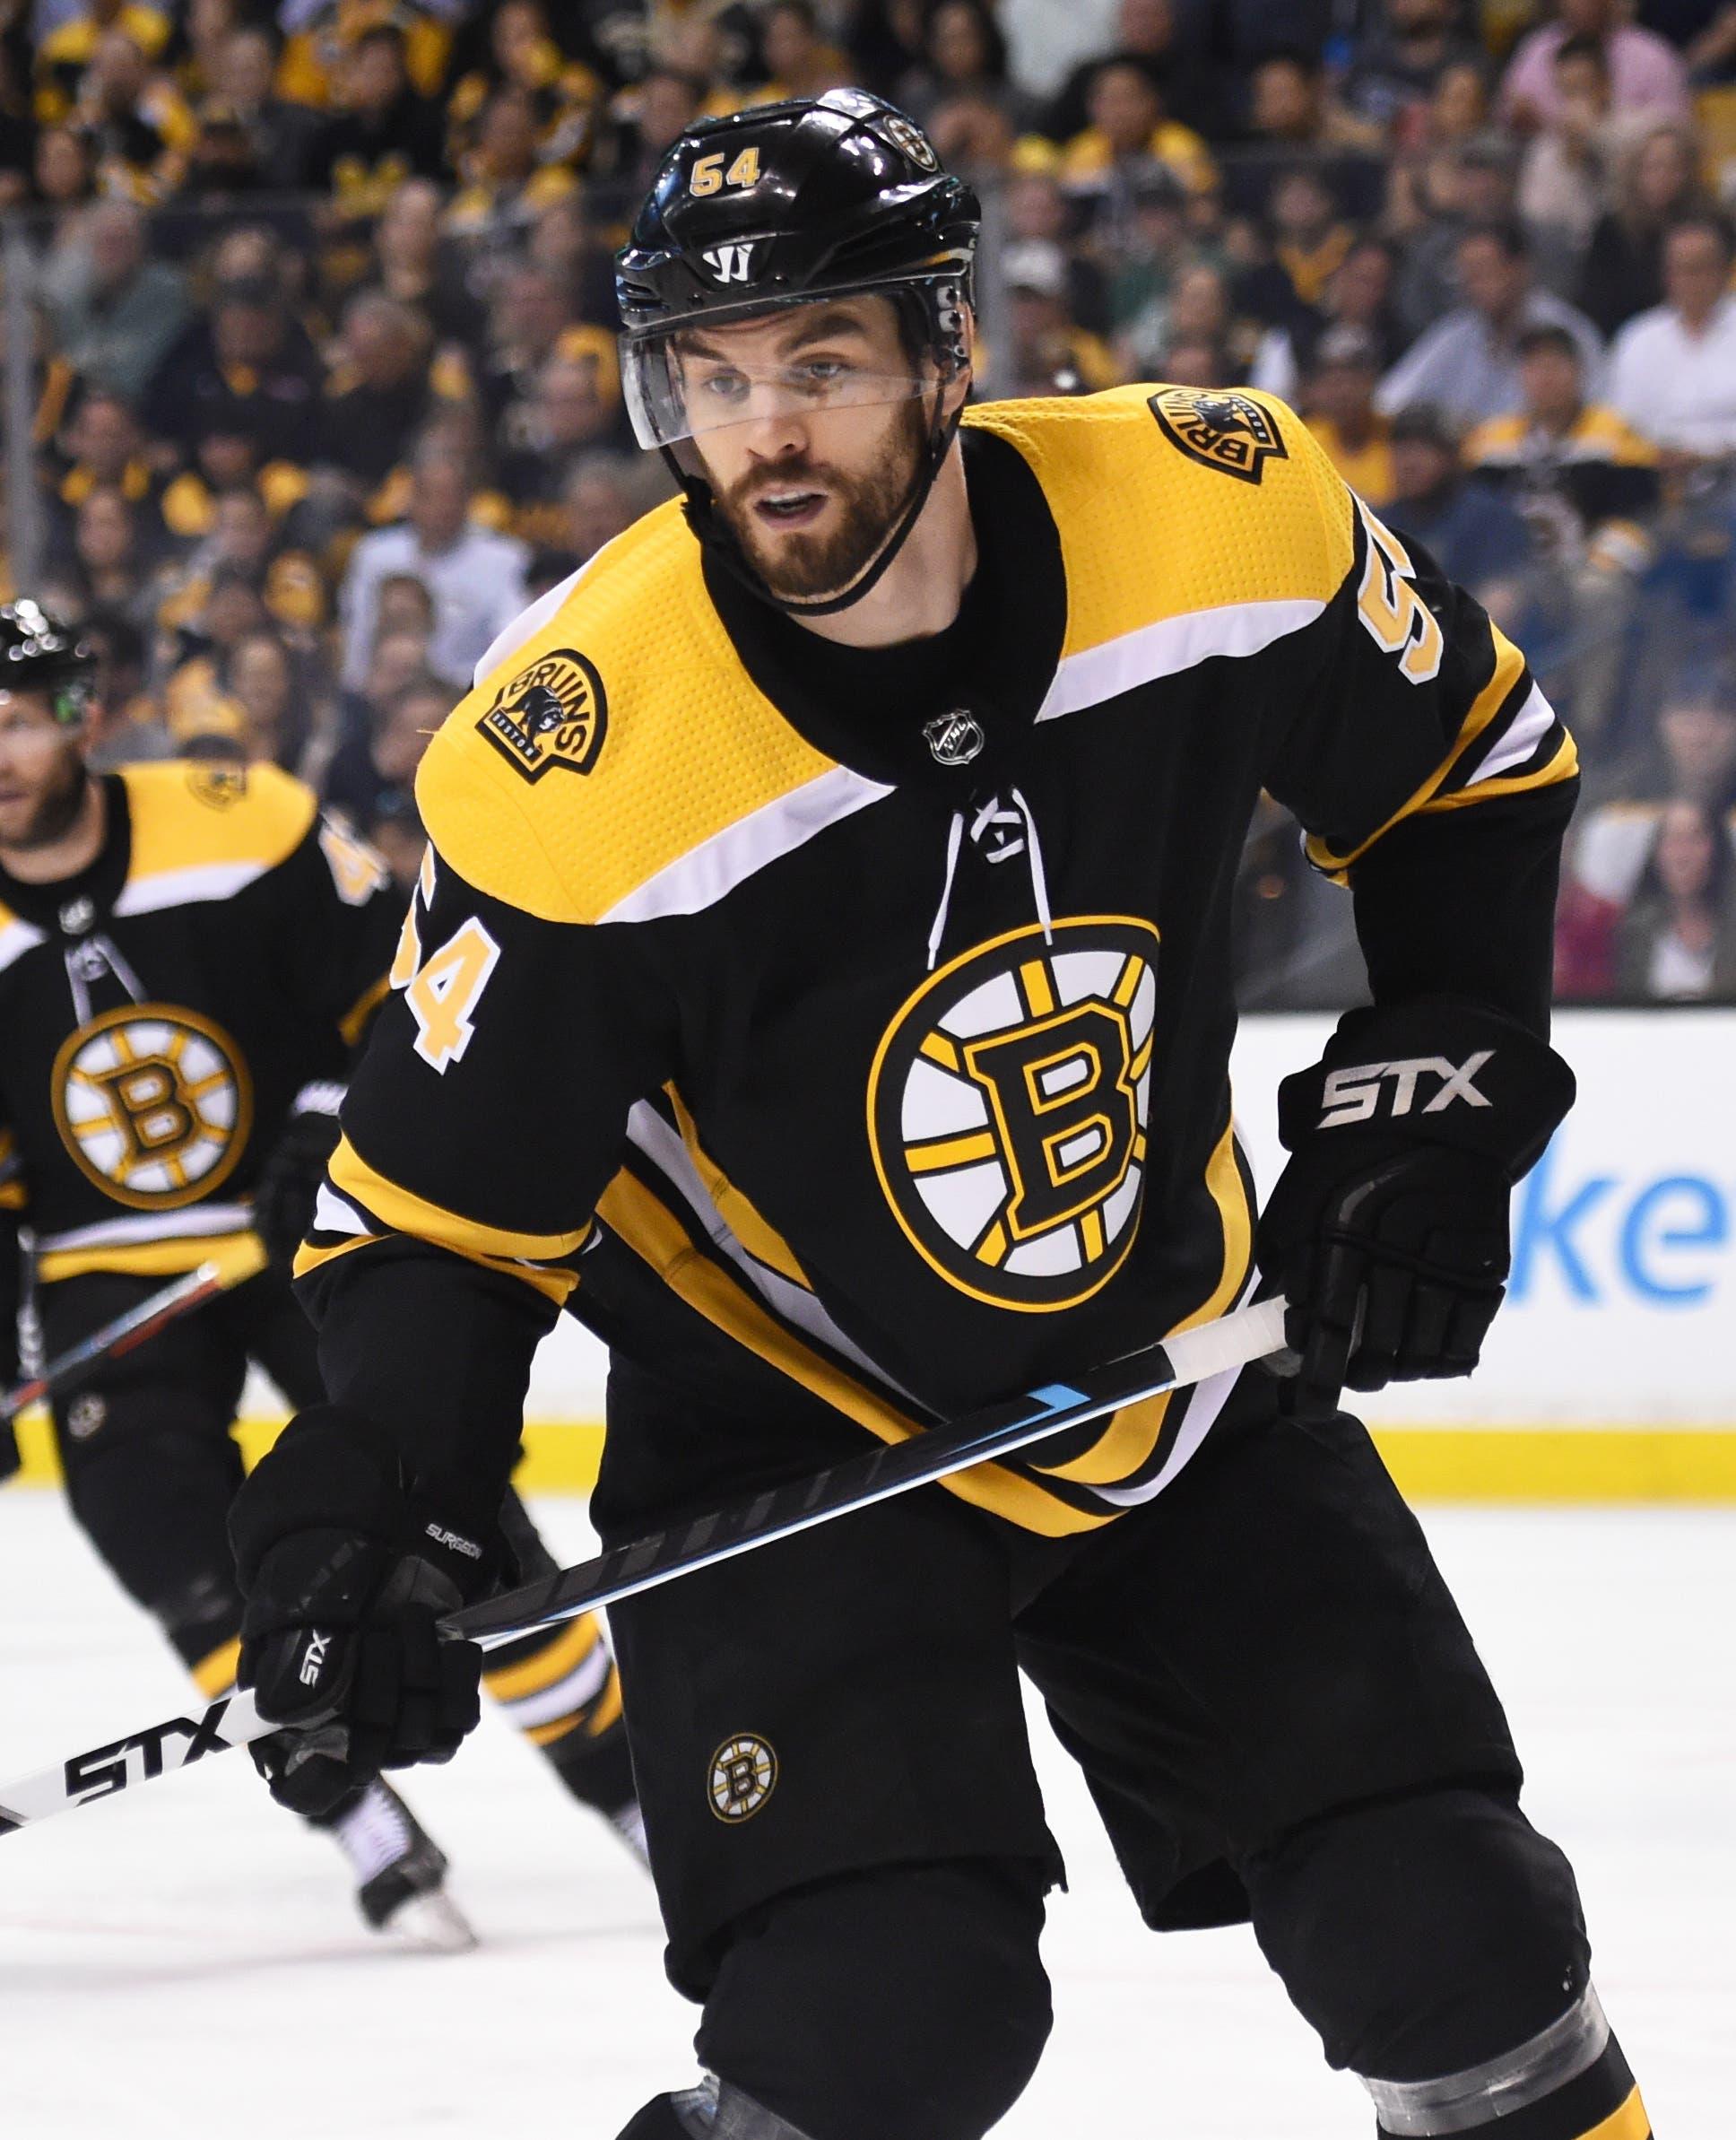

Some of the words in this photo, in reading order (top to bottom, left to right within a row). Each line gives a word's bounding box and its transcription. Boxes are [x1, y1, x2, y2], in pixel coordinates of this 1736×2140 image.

[690, 147, 761, 197] 54
[1164, 392, 1250, 465] BRUINS
[492, 713, 535, 756] BOSTON
[508, 662, 591, 755] BRUINS
[90, 1056, 200, 1177] B
[963, 1002, 1136, 1241] B
[1315, 1049, 1497, 1129] STX
[299, 1629, 332, 1689] STX
[65, 1698, 234, 1808] STX
[722, 1753, 759, 1804] B
